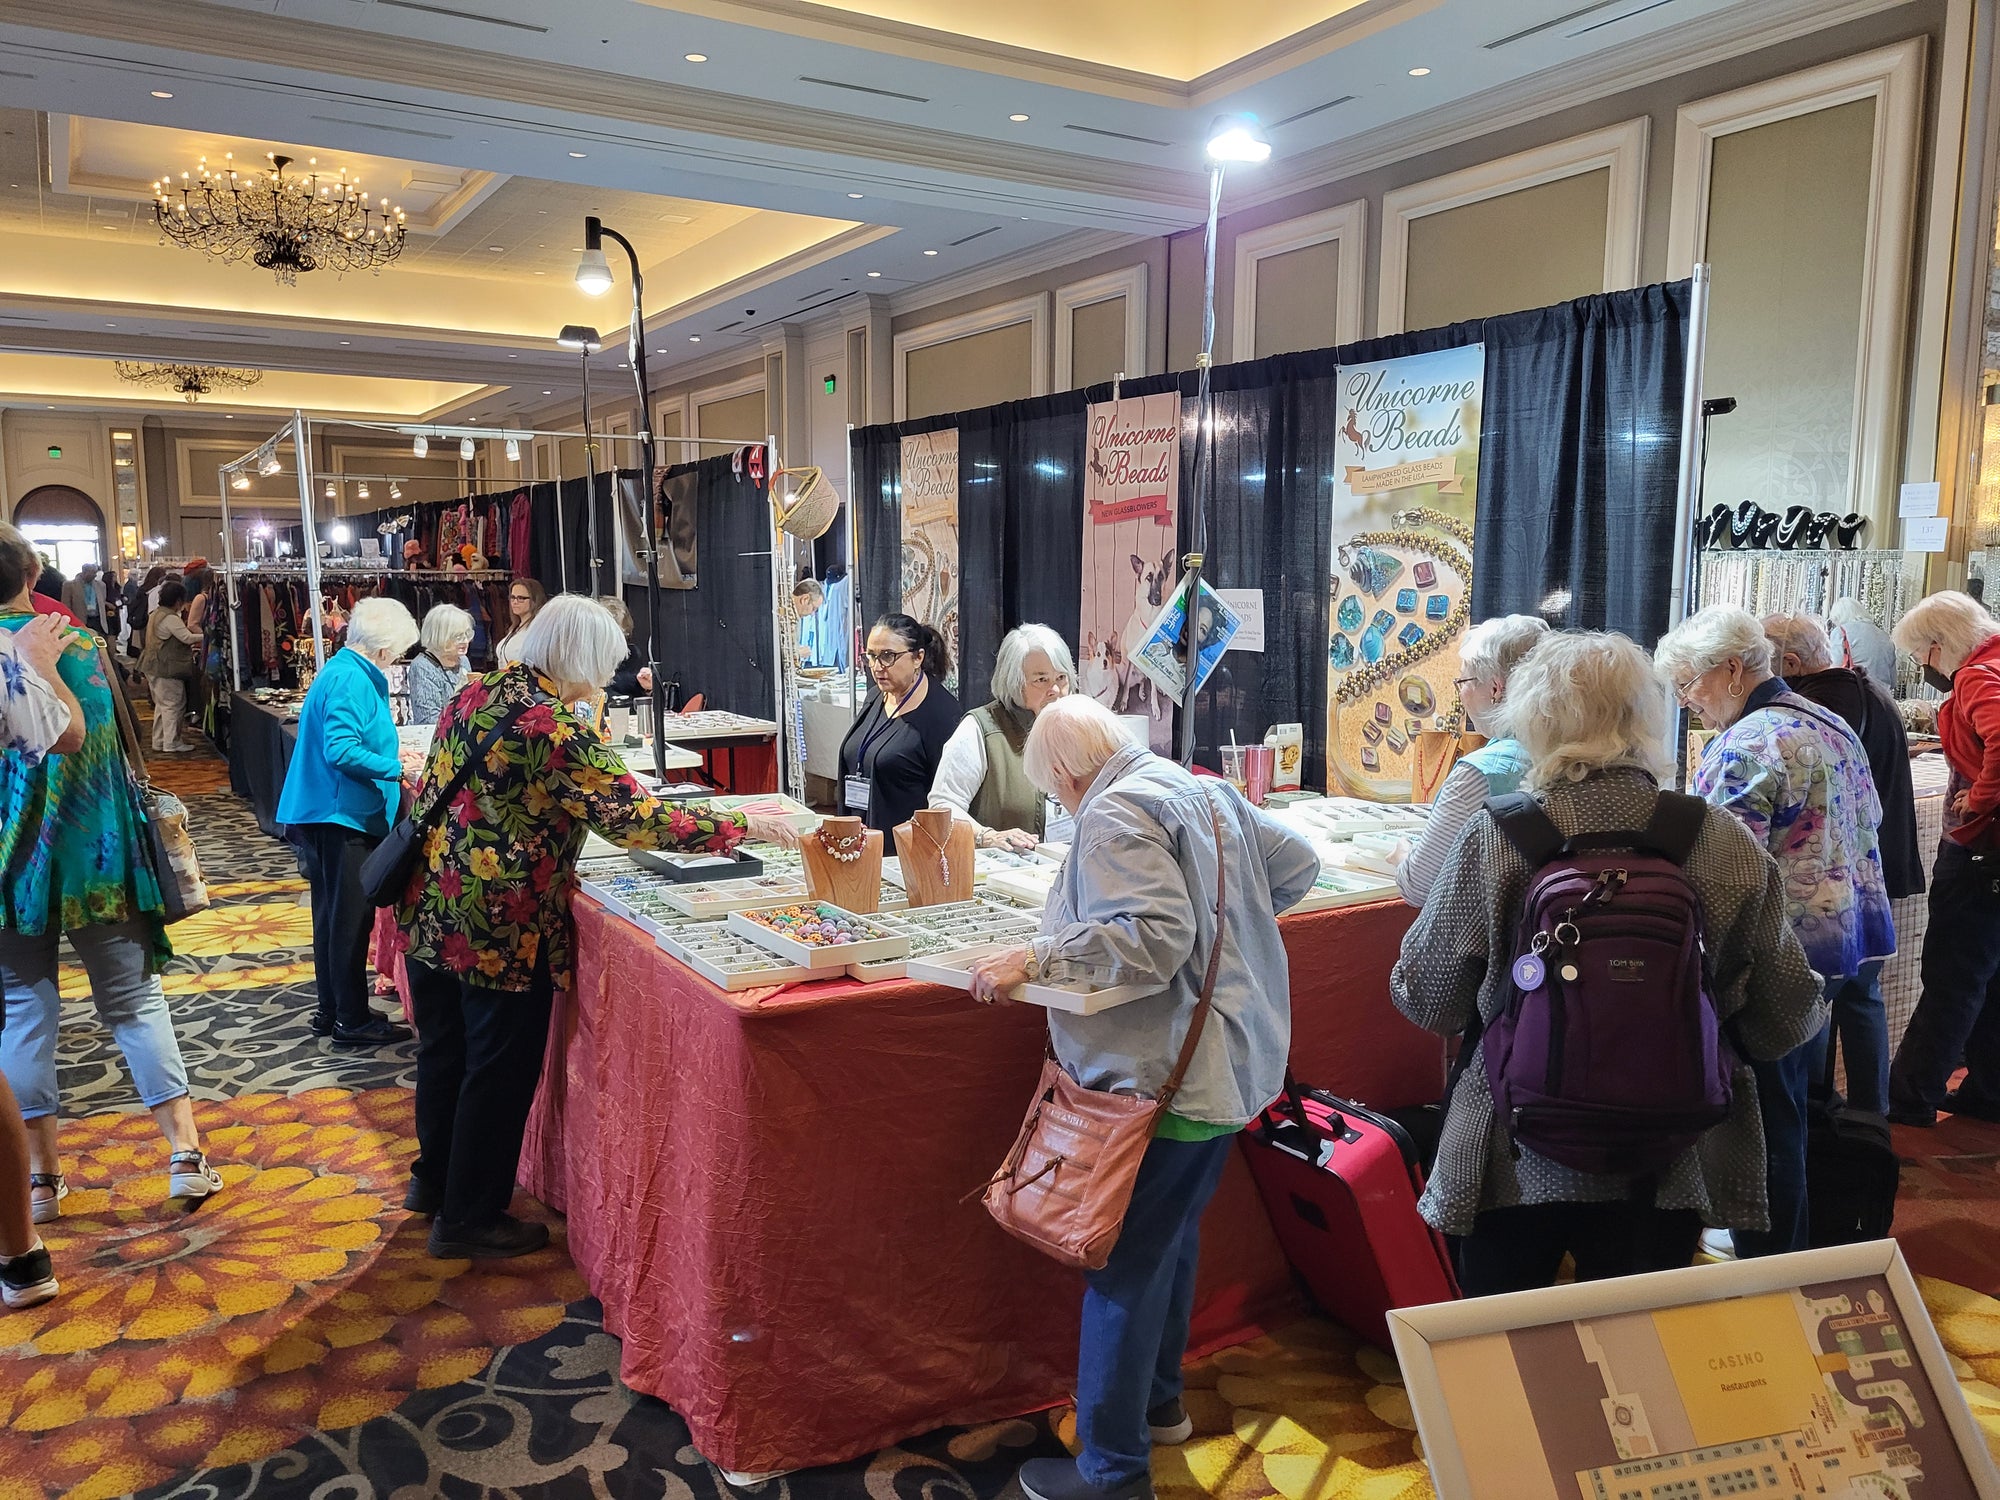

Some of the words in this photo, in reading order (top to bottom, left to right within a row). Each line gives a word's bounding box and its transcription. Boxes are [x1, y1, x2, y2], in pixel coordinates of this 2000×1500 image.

[1345, 370, 1475, 413] Unicorne
[1092, 414, 1176, 449] Unicorne
[1369, 408, 1463, 452] Beads
[904, 441, 958, 469] Unicorne
[1107, 450, 1168, 486] Beads
[1361, 468, 1402, 482] LAMPWORKED
[1402, 465, 1425, 475] GLASS
[1423, 462, 1443, 471] BEADS
[915, 468, 955, 497] Beads
[1376, 478, 1393, 489] MADE
[1394, 477, 1400, 486] IN
[1401, 475, 1412, 483] THE
[1413, 473, 1425, 481] USA
[1102, 510, 1112, 518] NEW
[1114, 501, 1158, 515] GLASSBLOWERS
[1609, 959, 1626, 967] TOM
[1708, 1352, 1764, 1370] CASINO
[1720, 1378, 1767, 1392] Restaurants
